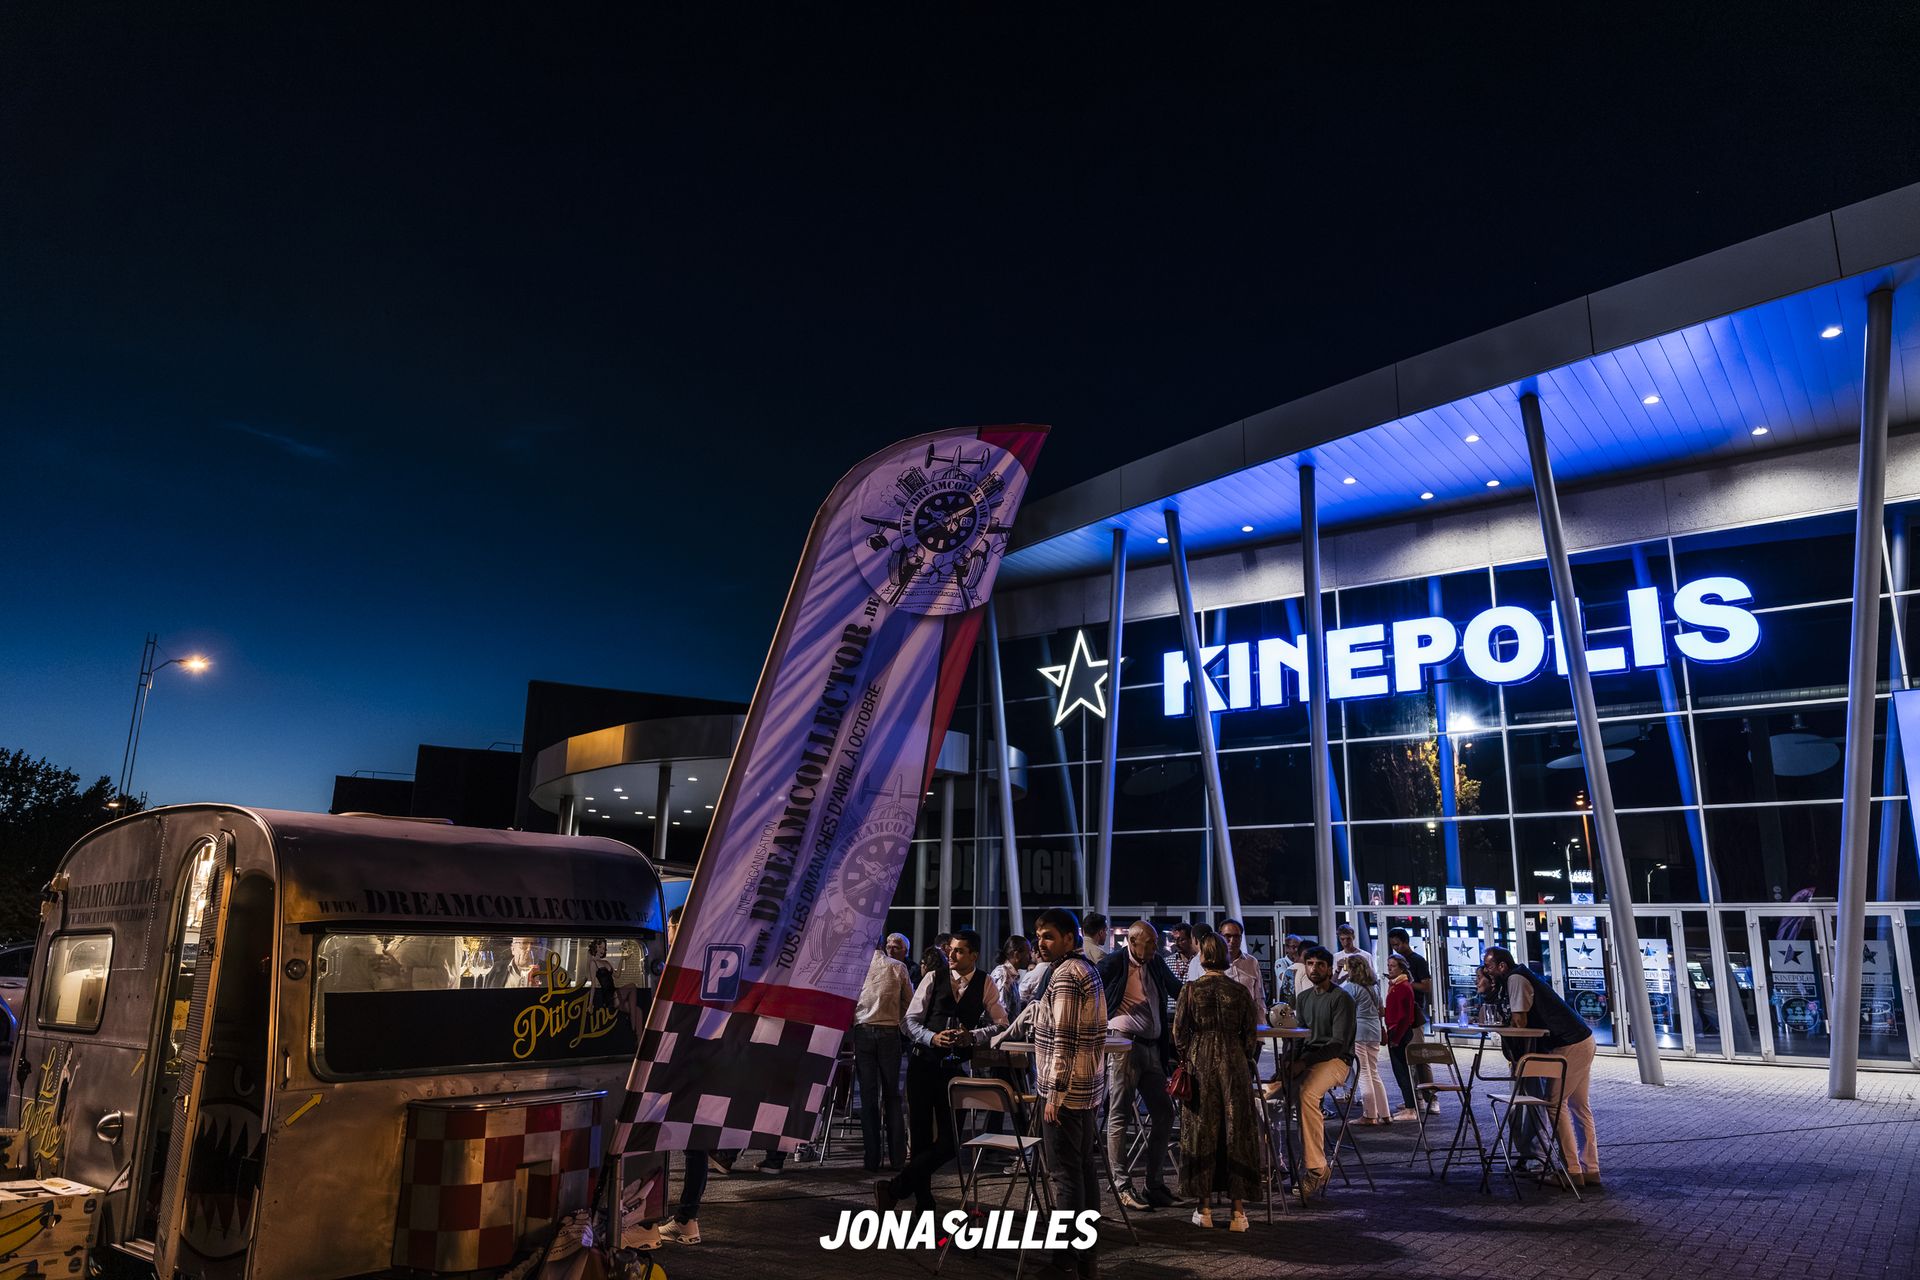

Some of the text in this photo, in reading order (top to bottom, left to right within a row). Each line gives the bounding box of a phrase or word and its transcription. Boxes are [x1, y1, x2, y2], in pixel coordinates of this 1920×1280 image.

[1163, 576, 1762, 716] KINEPOLIS
[848, 681, 881, 748] OCTOBRE
[827, 765, 856, 815] D'AVRIL
[736, 820, 777, 916] UNE ORGANISATION
[800, 816, 840, 904] DIMANCHES
[792, 904, 811, 932] LES
[776, 932, 800, 968] TOUS
[533, 952, 587, 1004] Le
[39, 1046, 58, 1098] Le
